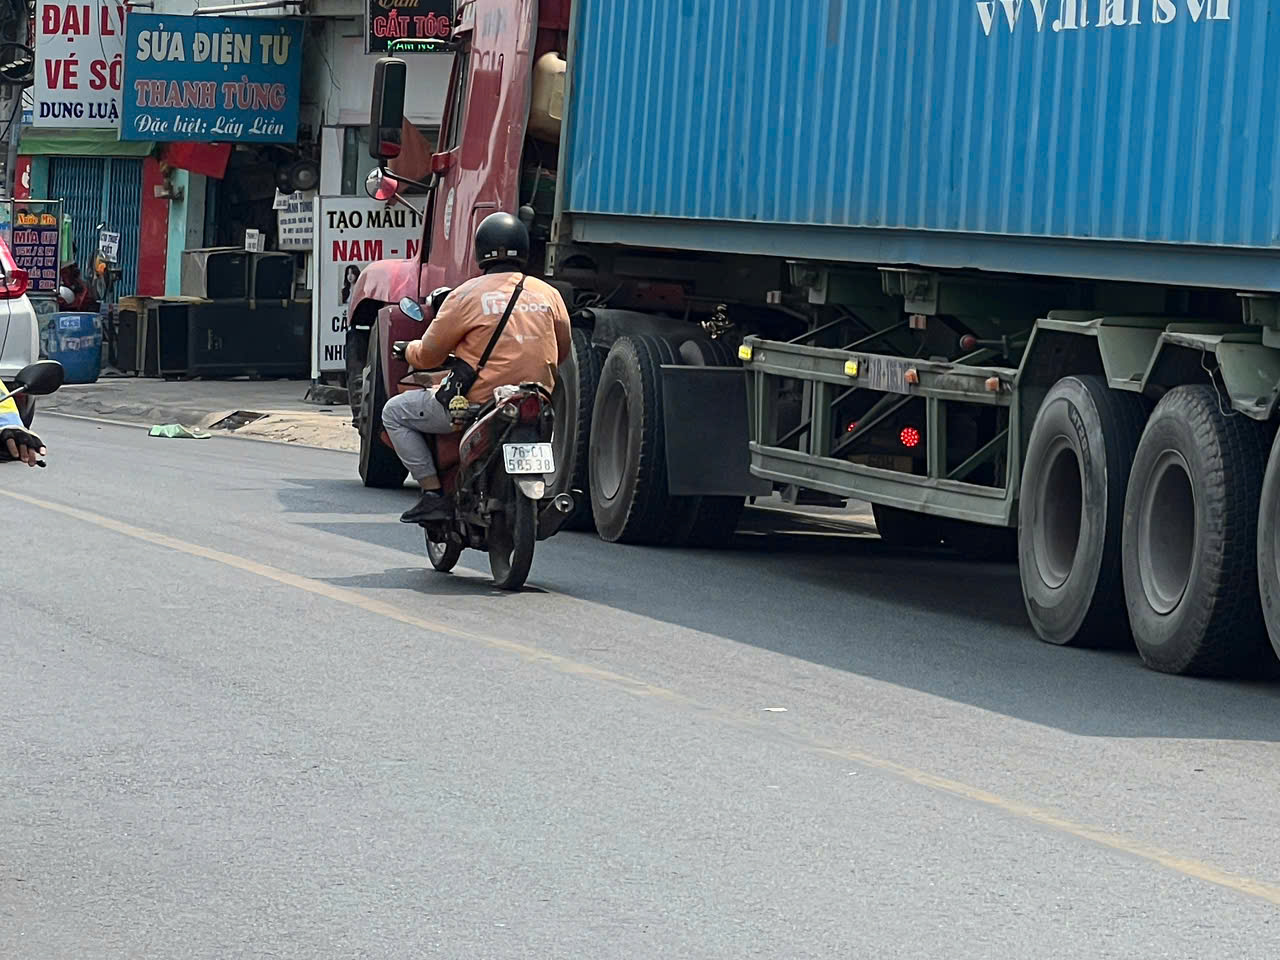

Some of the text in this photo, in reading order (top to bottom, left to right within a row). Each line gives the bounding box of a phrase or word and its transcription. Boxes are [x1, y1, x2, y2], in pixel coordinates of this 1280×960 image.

[42, 4, 89, 42] ĐẠI
[374, 9, 450, 37] CẮT TÓC
[136, 23, 291, 71] SỬA ĐIỆN TỬ
[44, 52, 79, 91] VÉ
[134, 75, 287, 111] THANH TÙNG
[40, 102, 84, 119] DUNG
[134, 114, 168, 134] Đặc
[173, 114, 207, 135] biệt:
[210, 114, 243, 138] Lấy
[327, 211, 363, 233] TẠO
[367, 204, 406, 228] MẪU
[332, 240, 383, 262] NAM
